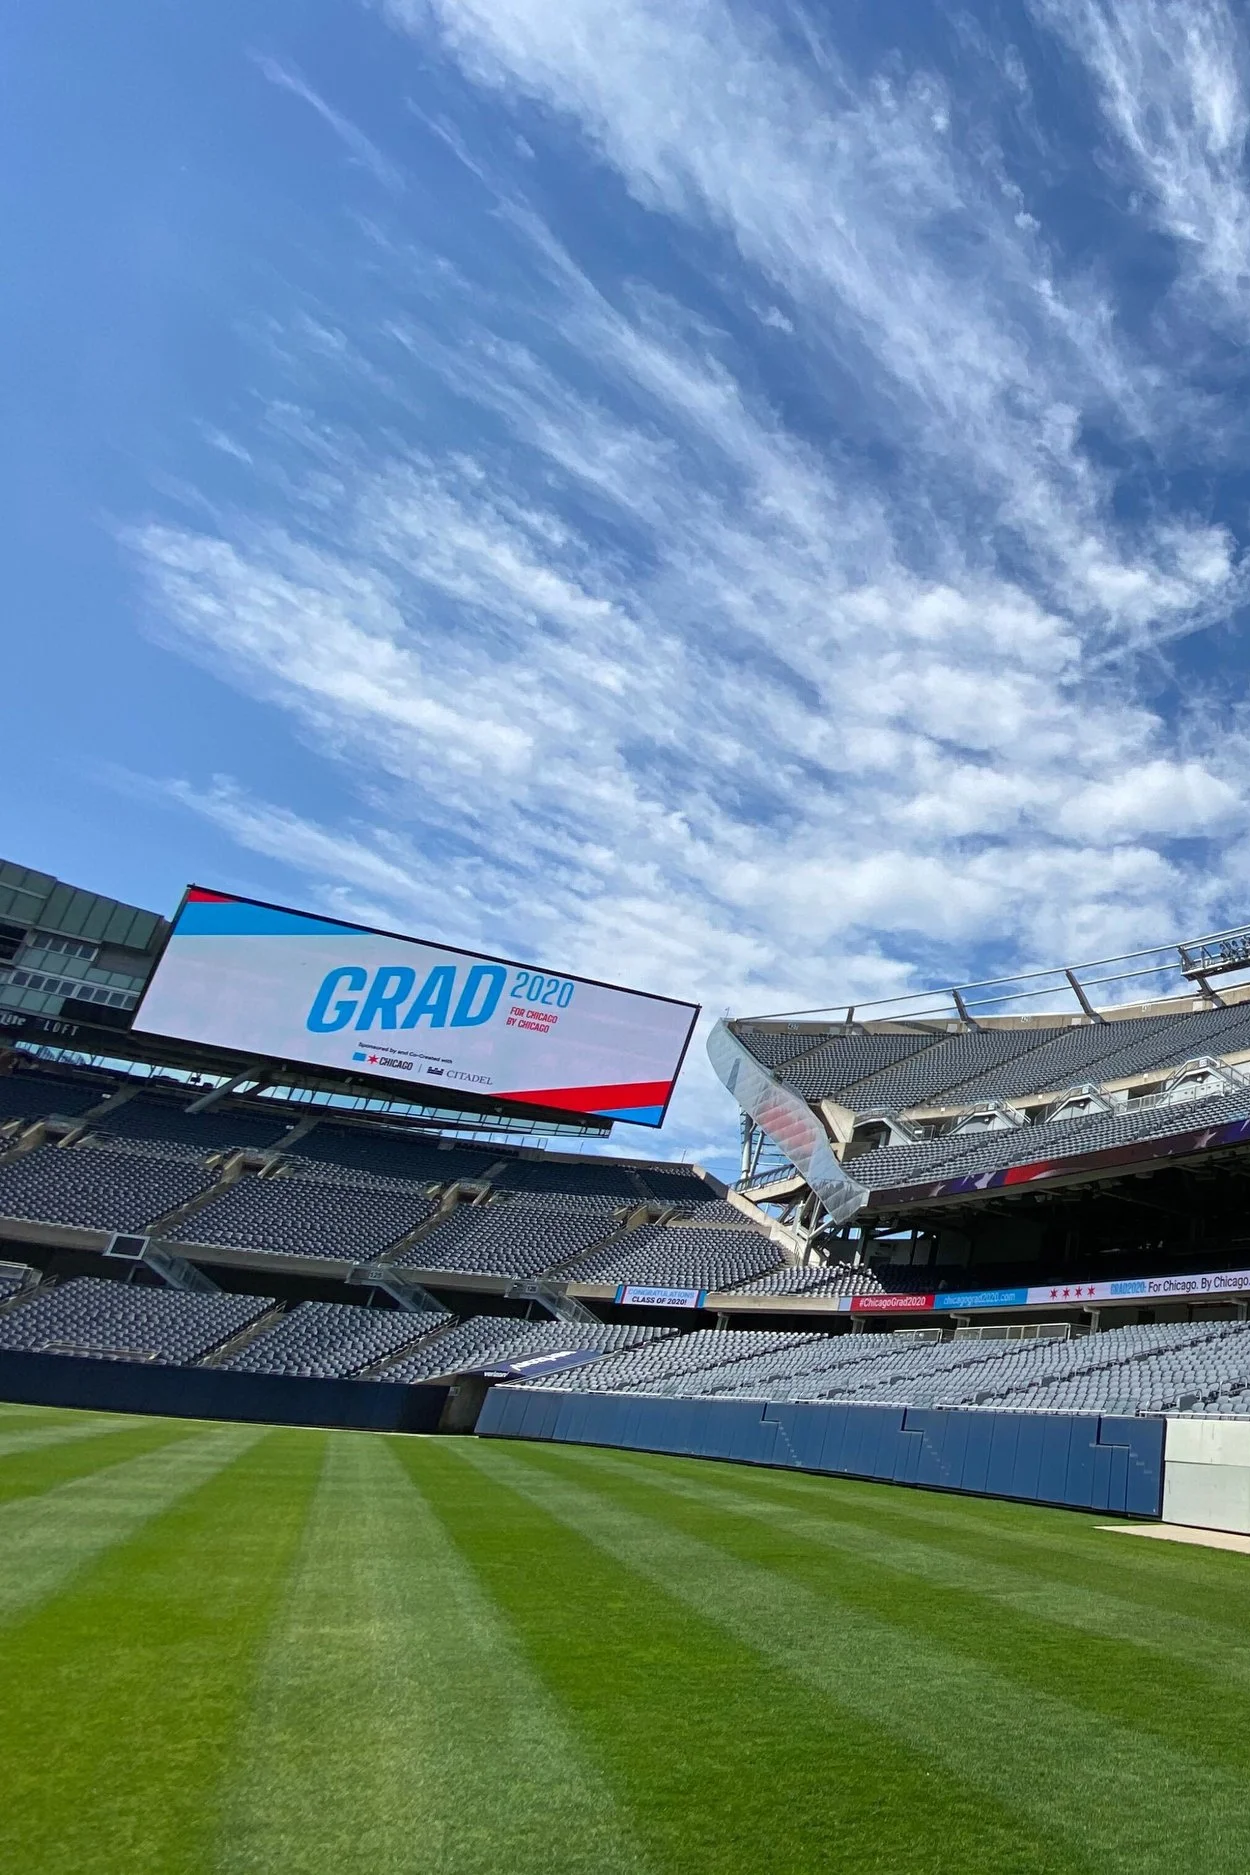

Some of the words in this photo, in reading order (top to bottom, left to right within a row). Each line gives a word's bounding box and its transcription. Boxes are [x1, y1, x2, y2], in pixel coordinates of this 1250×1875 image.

[306, 965, 507, 1033] GRAD
[510, 971, 575, 1009] 2020
[509, 1006, 525, 1018] FOR
[526, 1009, 558, 1025] CHICAGO
[43, 1020, 80, 1036] LOFT
[506, 1017, 516, 1026] BY
[517, 1019, 550, 1034] CHICAGO
[358, 1041, 389, 1053] Sponsored
[409, 1051, 440, 1062] Co-Created
[379, 1056, 414, 1071] CHICAGO
[446, 1069, 493, 1086] CITADEL
[1110, 1281, 1147, 1295] GRAD2020:
[1148, 1281, 1161, 1293] For
[1163, 1279, 1199, 1293] Chicago.
[1201, 1277, 1212, 1291] By
[1213, 1275, 1250, 1290] Chicago.
[631, 1295, 655, 1304] CLASS
[667, 1298, 687, 1306] 2020!
[859, 1296, 926, 1309] #ChicagoGrad2020
[943, 1292, 1015, 1307] chicagograd2020.com
